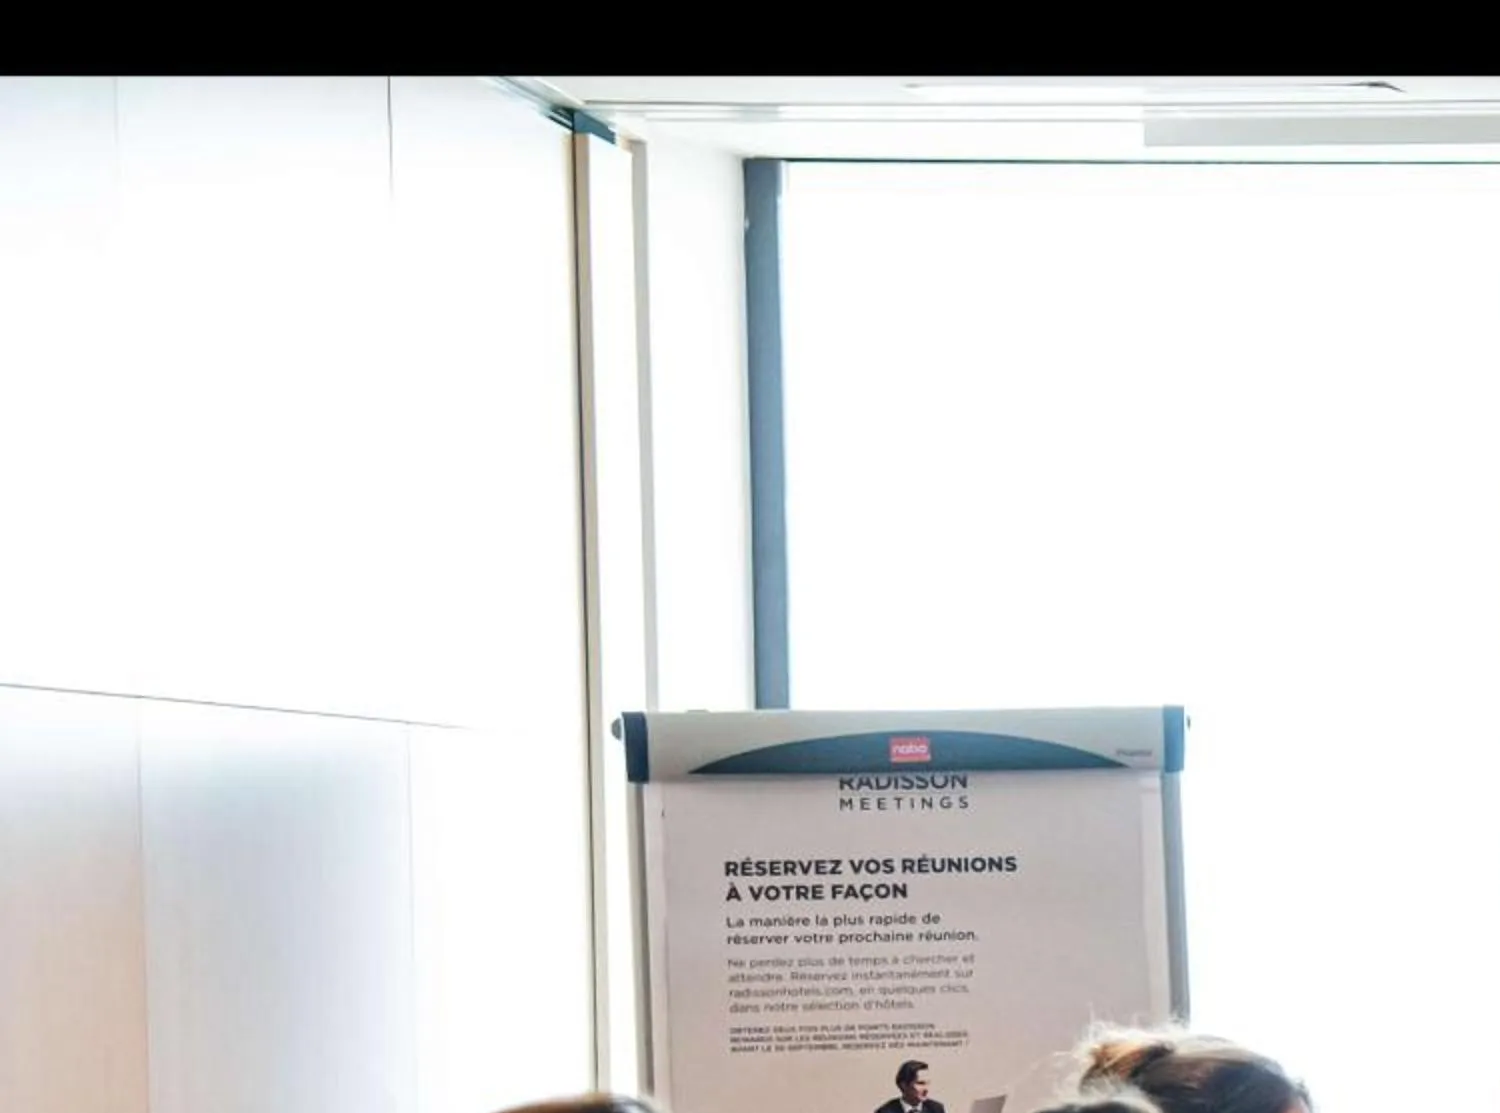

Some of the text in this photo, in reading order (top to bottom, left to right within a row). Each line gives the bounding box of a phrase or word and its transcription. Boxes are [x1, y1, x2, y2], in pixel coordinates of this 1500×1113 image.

[839, 774, 968, 790] RADISSON
[839, 796, 969, 811] MEETINGS
[724, 854, 1018, 877] RÉSERVEZ VOS RÉUNIONS
[725, 882, 908, 902] À VOTRE FAÇON
[726, 912, 941, 929] La manière la plus rapide de
[727, 928, 979, 946] réserver votre prochaine réunion.
